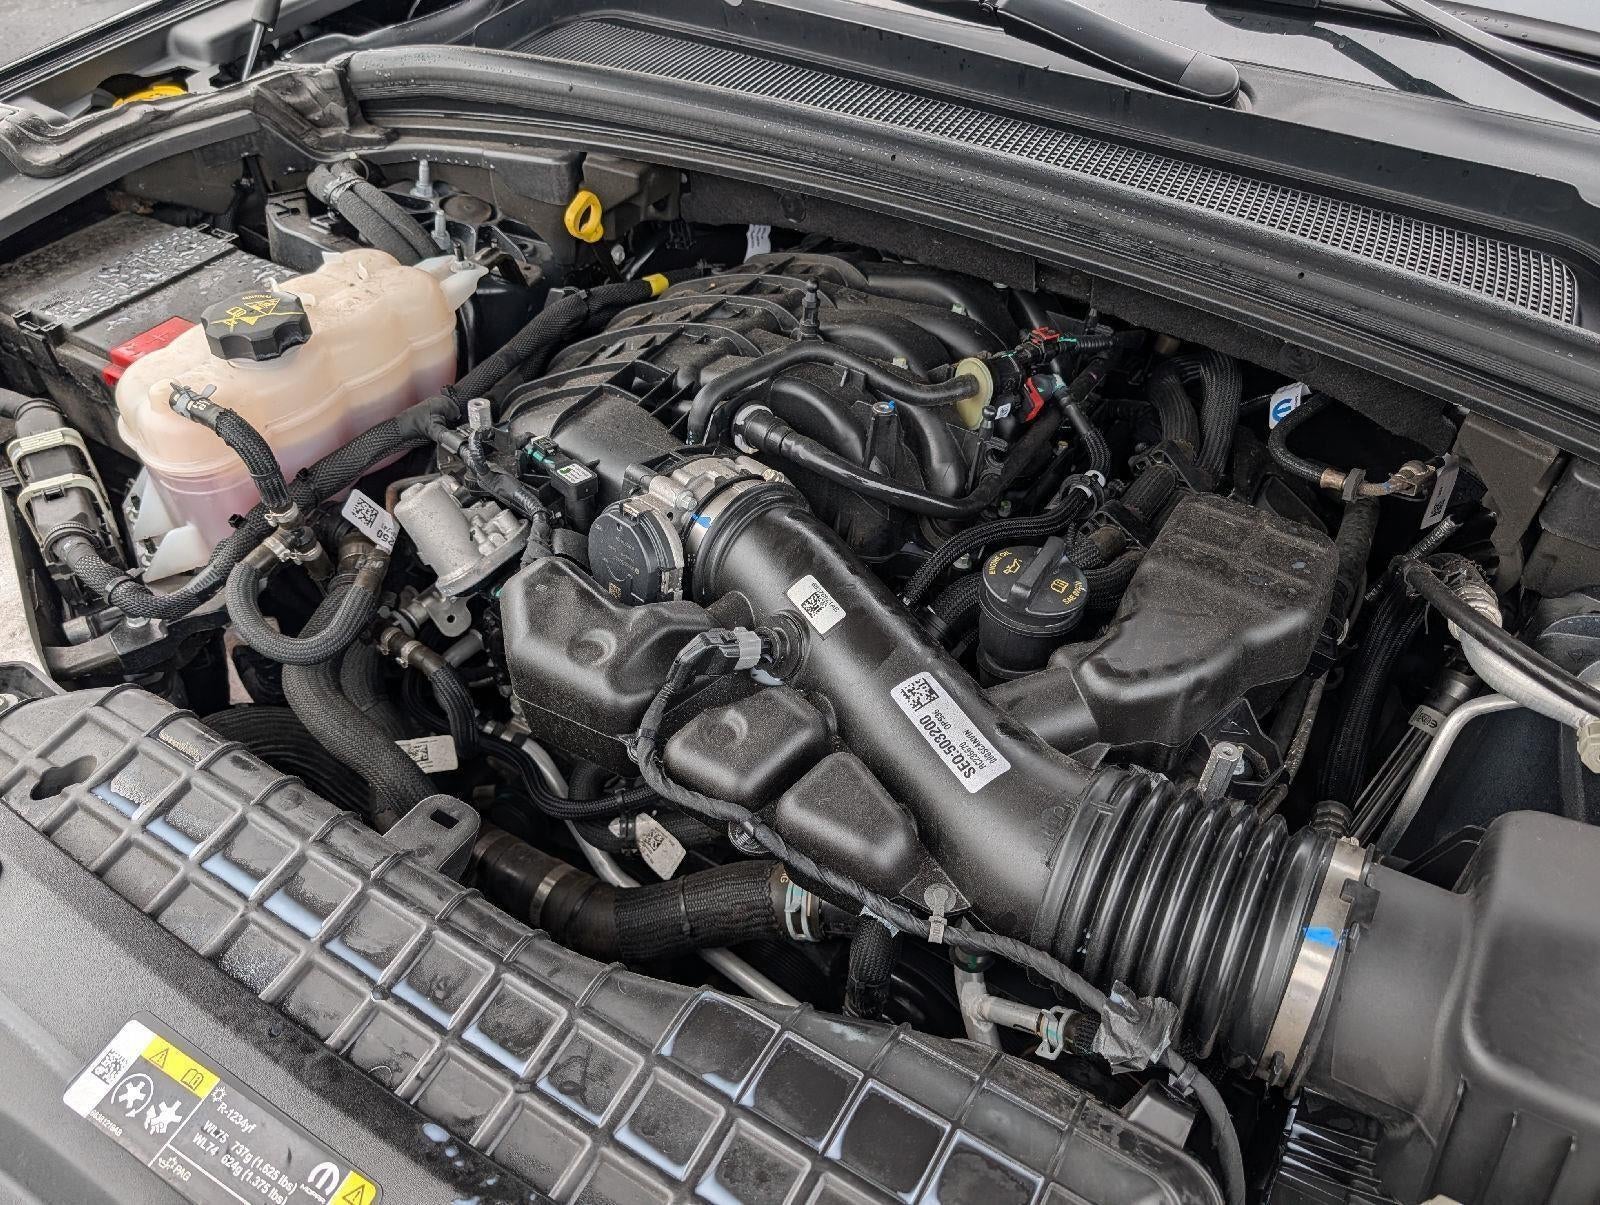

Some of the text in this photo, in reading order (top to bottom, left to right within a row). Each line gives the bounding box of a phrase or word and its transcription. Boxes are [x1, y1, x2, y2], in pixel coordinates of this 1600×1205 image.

[919, 714, 976, 779] SEQ:503200
[216, 1101, 257, 1134] R-1234yf
[172, 1164, 192, 1182] PAG
[192, 1132, 220, 1156] WL74
[221, 1154, 244, 1177] 624g
[240, 1168, 272, 1194] (1.375
[203, 1119, 298, 1196] WL75 737g (1.625 lbs)
